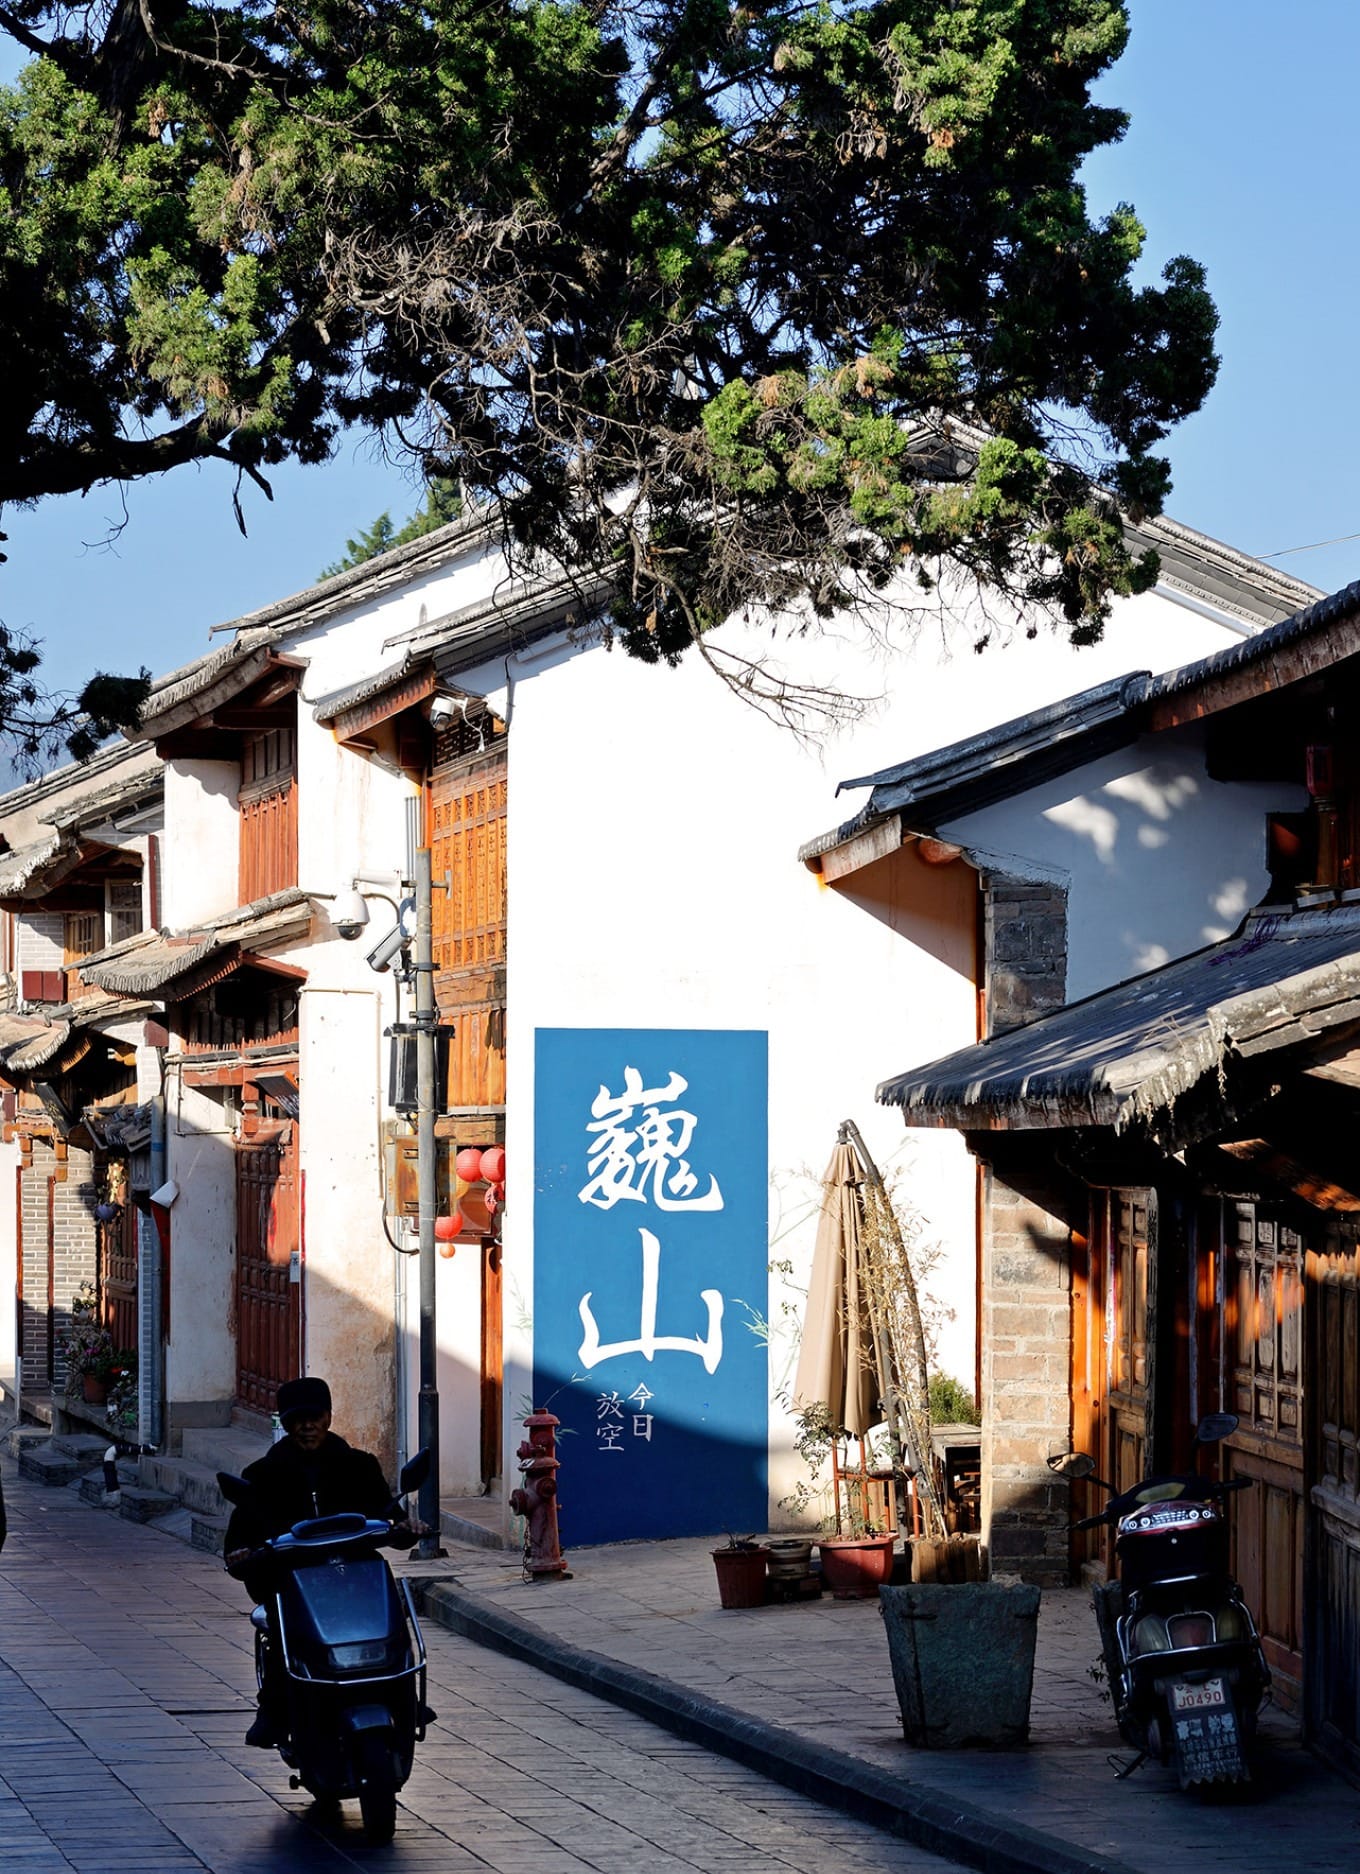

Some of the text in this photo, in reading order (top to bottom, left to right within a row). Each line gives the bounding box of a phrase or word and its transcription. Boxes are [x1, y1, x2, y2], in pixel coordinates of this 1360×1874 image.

[578, 1065, 724, 1376] 巍山
[596, 1391, 625, 1452] 放空
[627, 1381, 655, 1443] 今日
